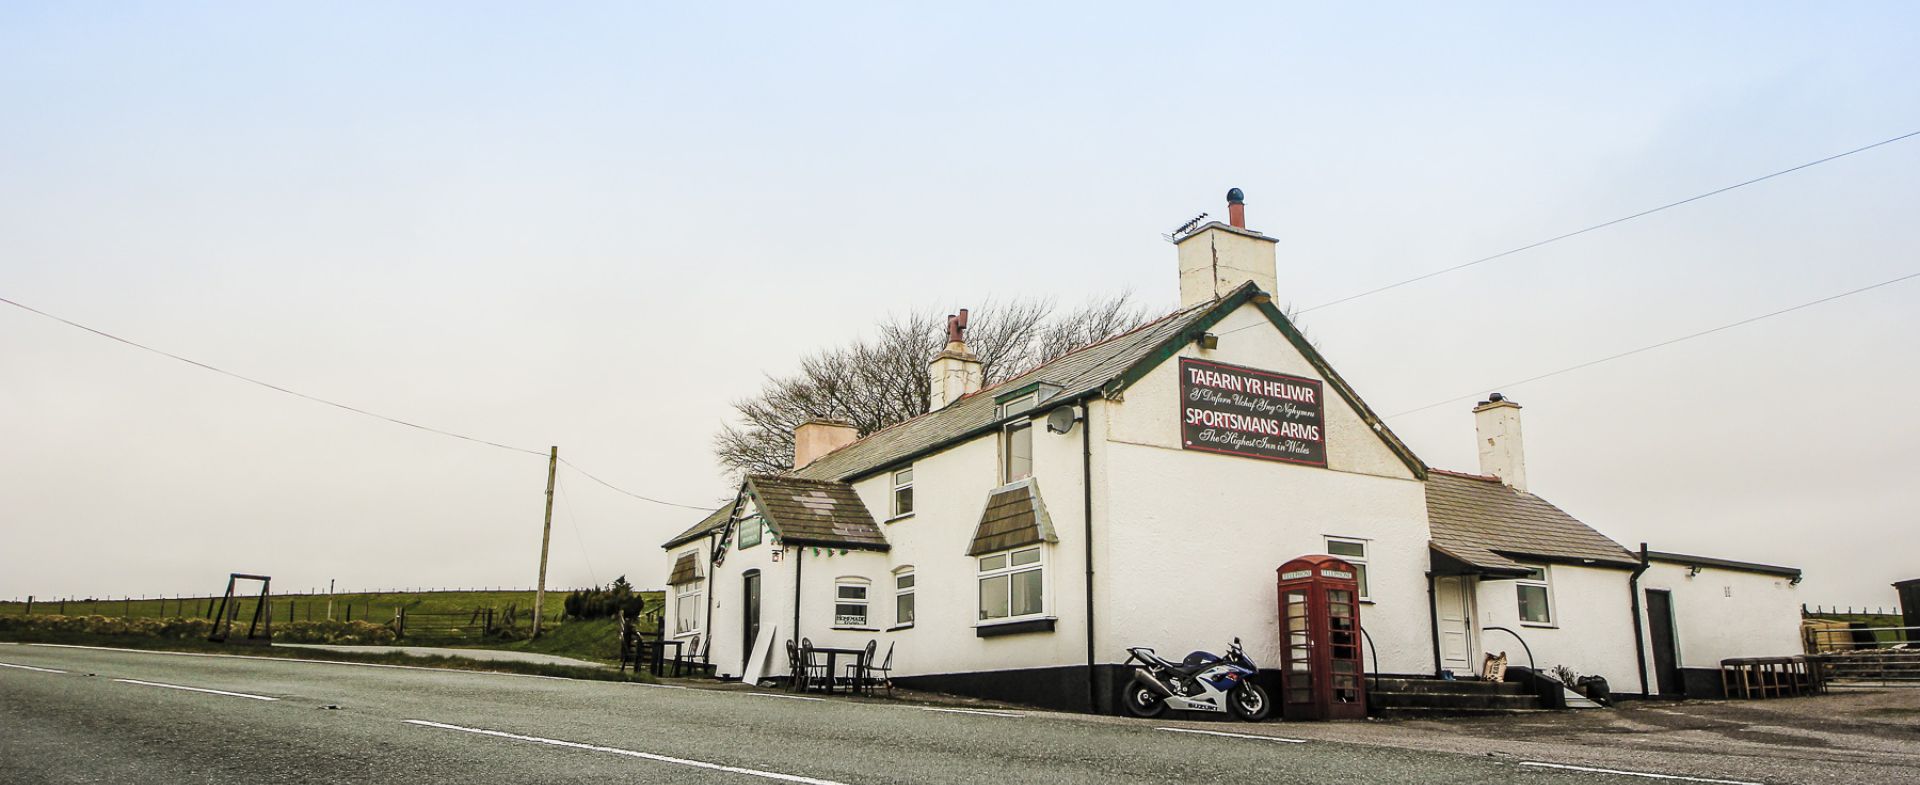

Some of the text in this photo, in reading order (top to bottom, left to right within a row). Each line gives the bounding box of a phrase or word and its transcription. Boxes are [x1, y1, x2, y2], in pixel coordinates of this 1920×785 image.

[1188, 368, 1315, 403] TAFARN YR HELIWR
[1202, 388, 1231, 405] Dafarn
[1232, 394, 1256, 411] Uchaf
[1256, 398, 1275, 414] Yng
[1276, 403, 1315, 419] Nghymru
[1186, 408, 1320, 441] SPORTSMANS ARMS
[1199, 429, 1310, 454] The Highest Inn in Wales
[1188, 703, 1217, 711] SUZUKI
